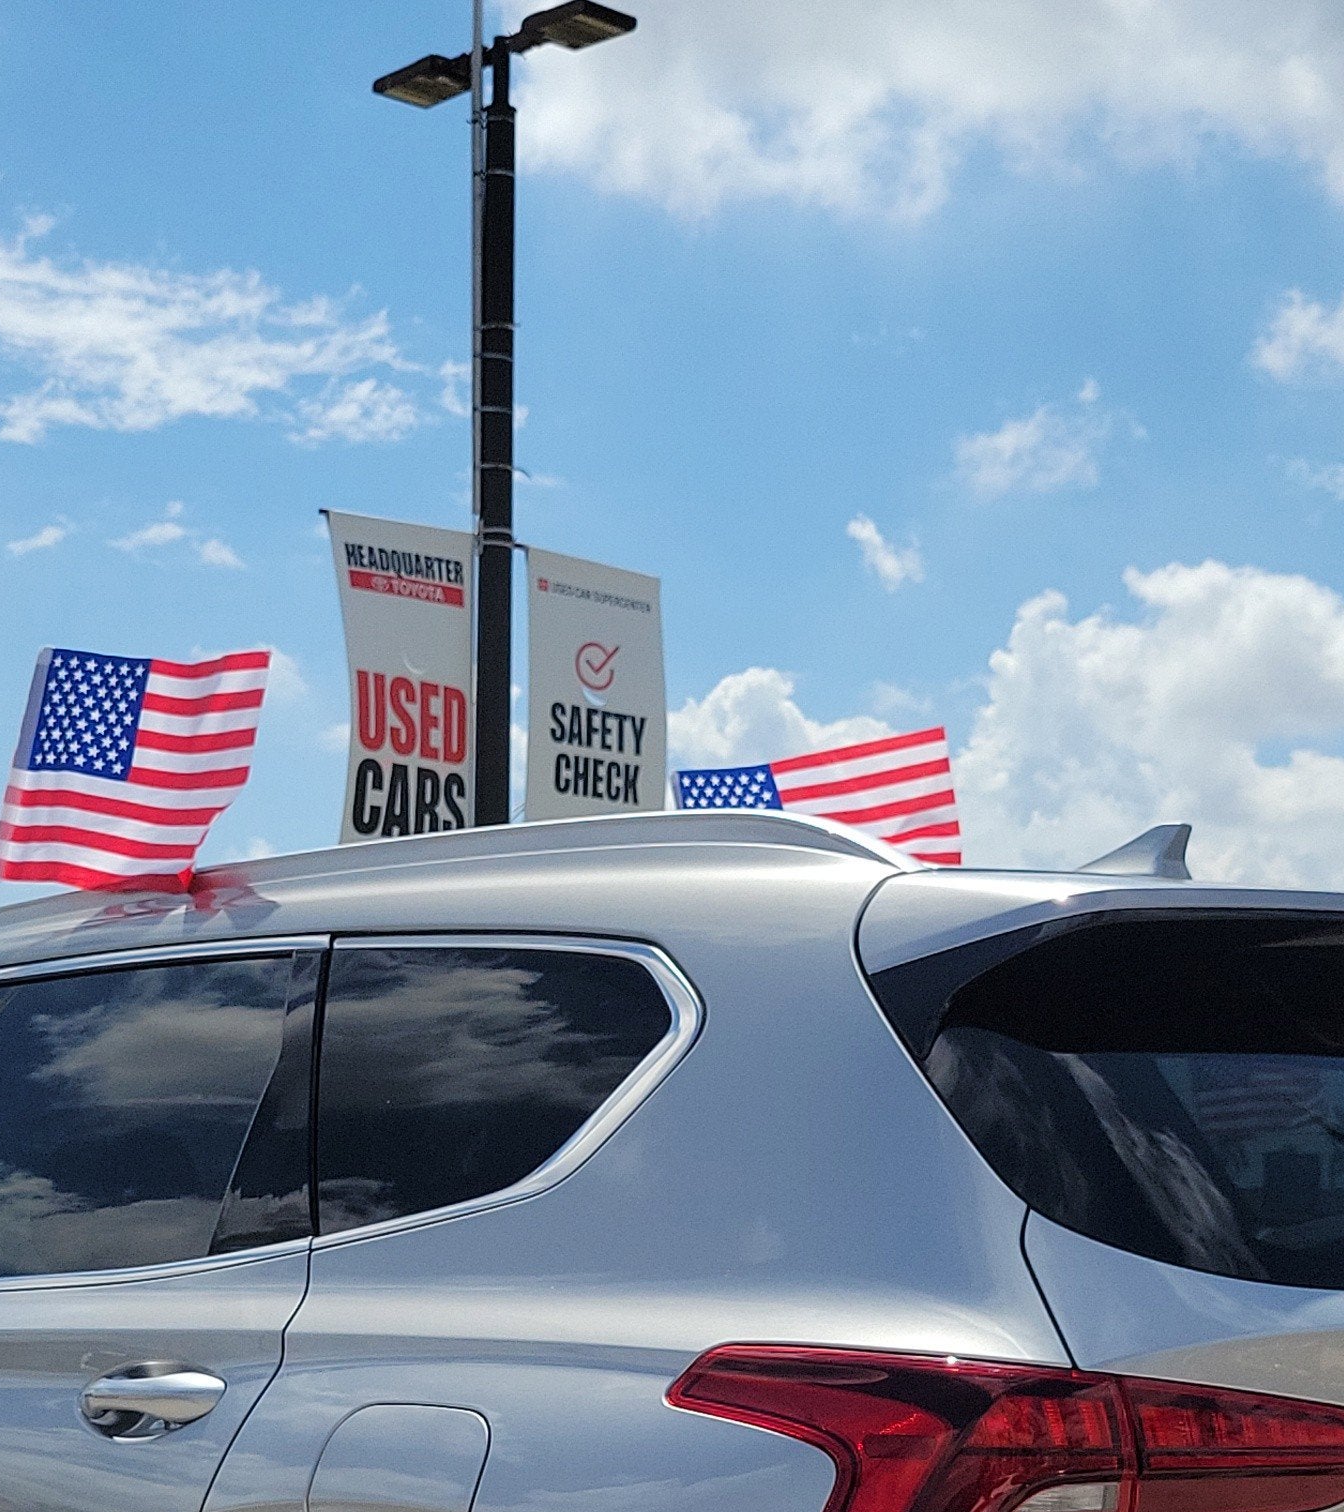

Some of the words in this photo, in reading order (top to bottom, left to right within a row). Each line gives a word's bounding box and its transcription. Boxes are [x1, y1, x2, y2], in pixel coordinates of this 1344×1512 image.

[344, 542, 464, 584] HEADQUARTER
[356, 669, 468, 764] USED
[550, 702, 646, 755] SAFETY
[352, 758, 466, 837] CARS
[555, 753, 640, 805] CHECK
